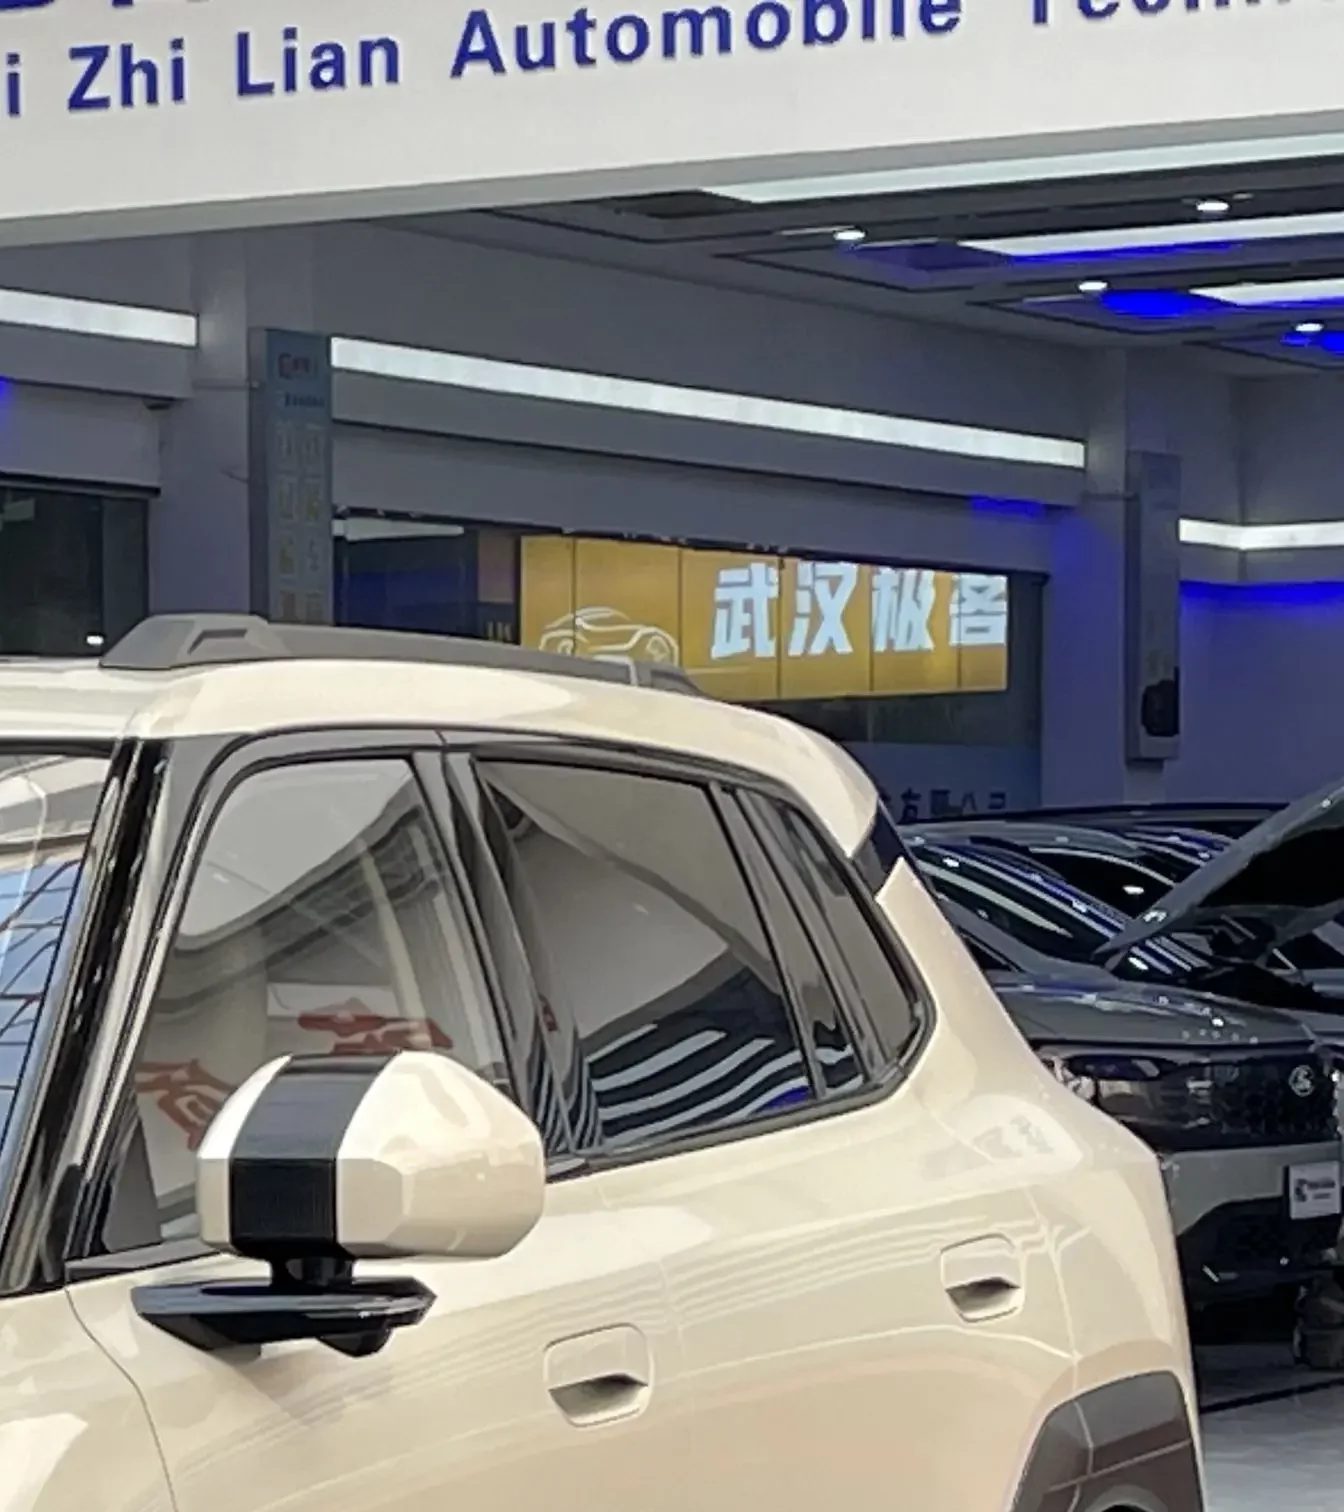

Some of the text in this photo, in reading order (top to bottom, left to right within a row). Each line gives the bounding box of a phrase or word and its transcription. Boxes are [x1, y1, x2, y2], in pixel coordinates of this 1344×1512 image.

[67, 37, 186, 112] Zhi
[235, 26, 401, 97] Lian
[449, 0, 962, 78] Automobile
